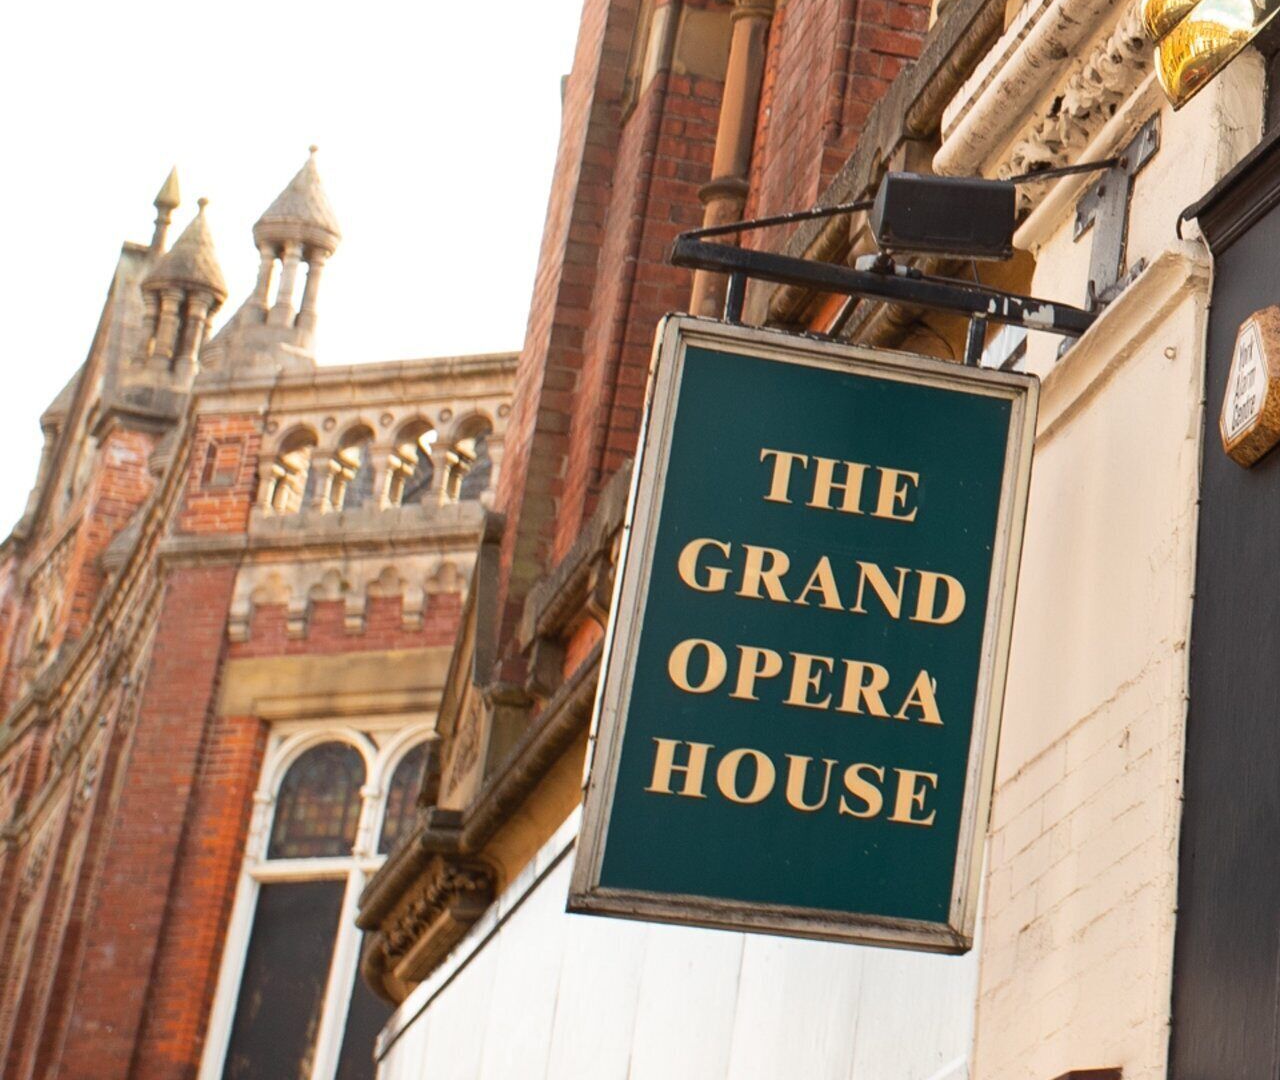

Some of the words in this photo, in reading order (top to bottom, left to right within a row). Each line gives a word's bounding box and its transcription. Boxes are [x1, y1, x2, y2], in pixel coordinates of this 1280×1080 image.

[761, 449, 919, 523] THE
[677, 538, 966, 626] GRAND
[667, 638, 944, 726] OPERA
[644, 737, 938, 827] HOUSE
